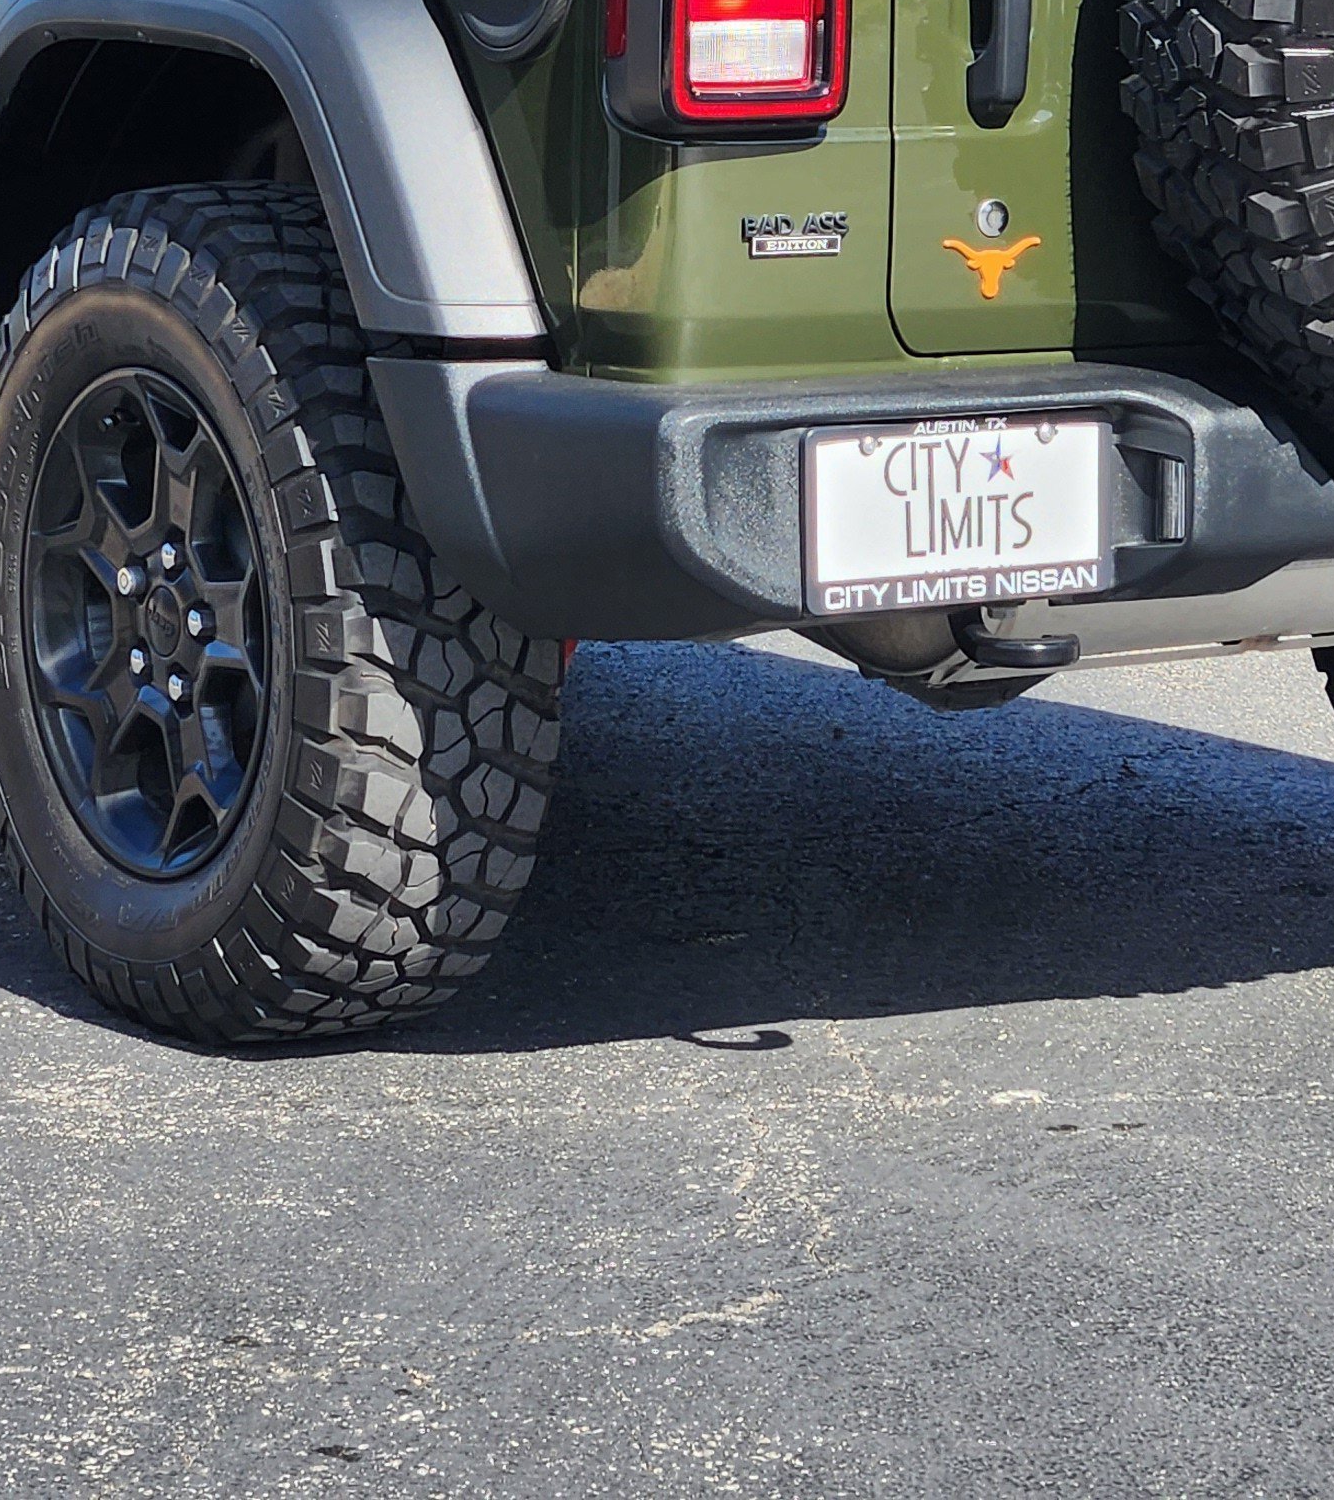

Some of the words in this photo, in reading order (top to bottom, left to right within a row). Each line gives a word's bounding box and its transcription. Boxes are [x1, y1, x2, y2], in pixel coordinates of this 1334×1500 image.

[741, 212, 794, 240] BAD
[802, 211, 850, 237] ASS
[765, 239, 829, 251] EDITION
[984, 417, 1008, 431] TX
[884, 437, 971, 512] CITY
[905, 491, 1035, 559] LIMITS
[824, 582, 890, 612] CITY
[895, 574, 988, 605] LIMITS
[994, 563, 1099, 597] NISSAN
